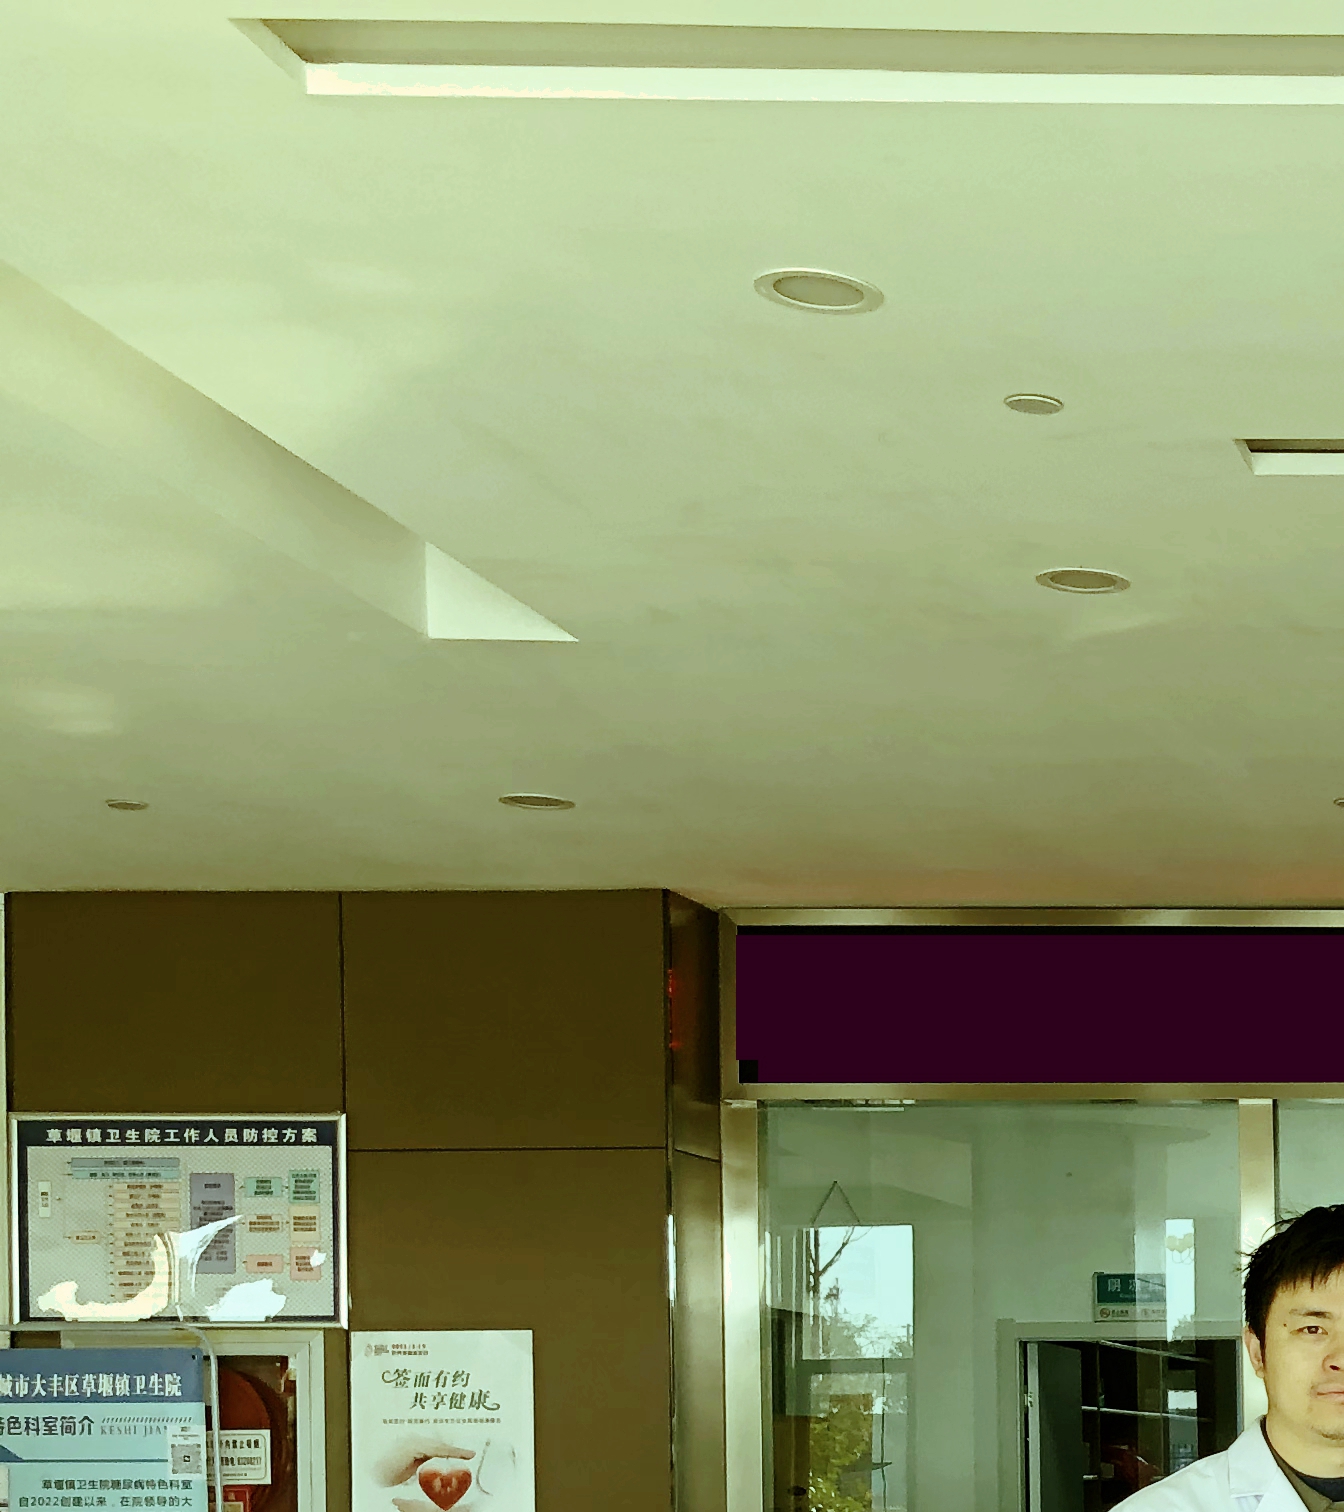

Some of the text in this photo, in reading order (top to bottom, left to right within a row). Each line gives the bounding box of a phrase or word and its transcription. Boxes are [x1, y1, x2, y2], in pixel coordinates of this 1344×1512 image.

[46, 1127, 319, 1144] 草堰镇卫生院工作人员防控方案
[409, 1389, 501, 1411] 共享健康
